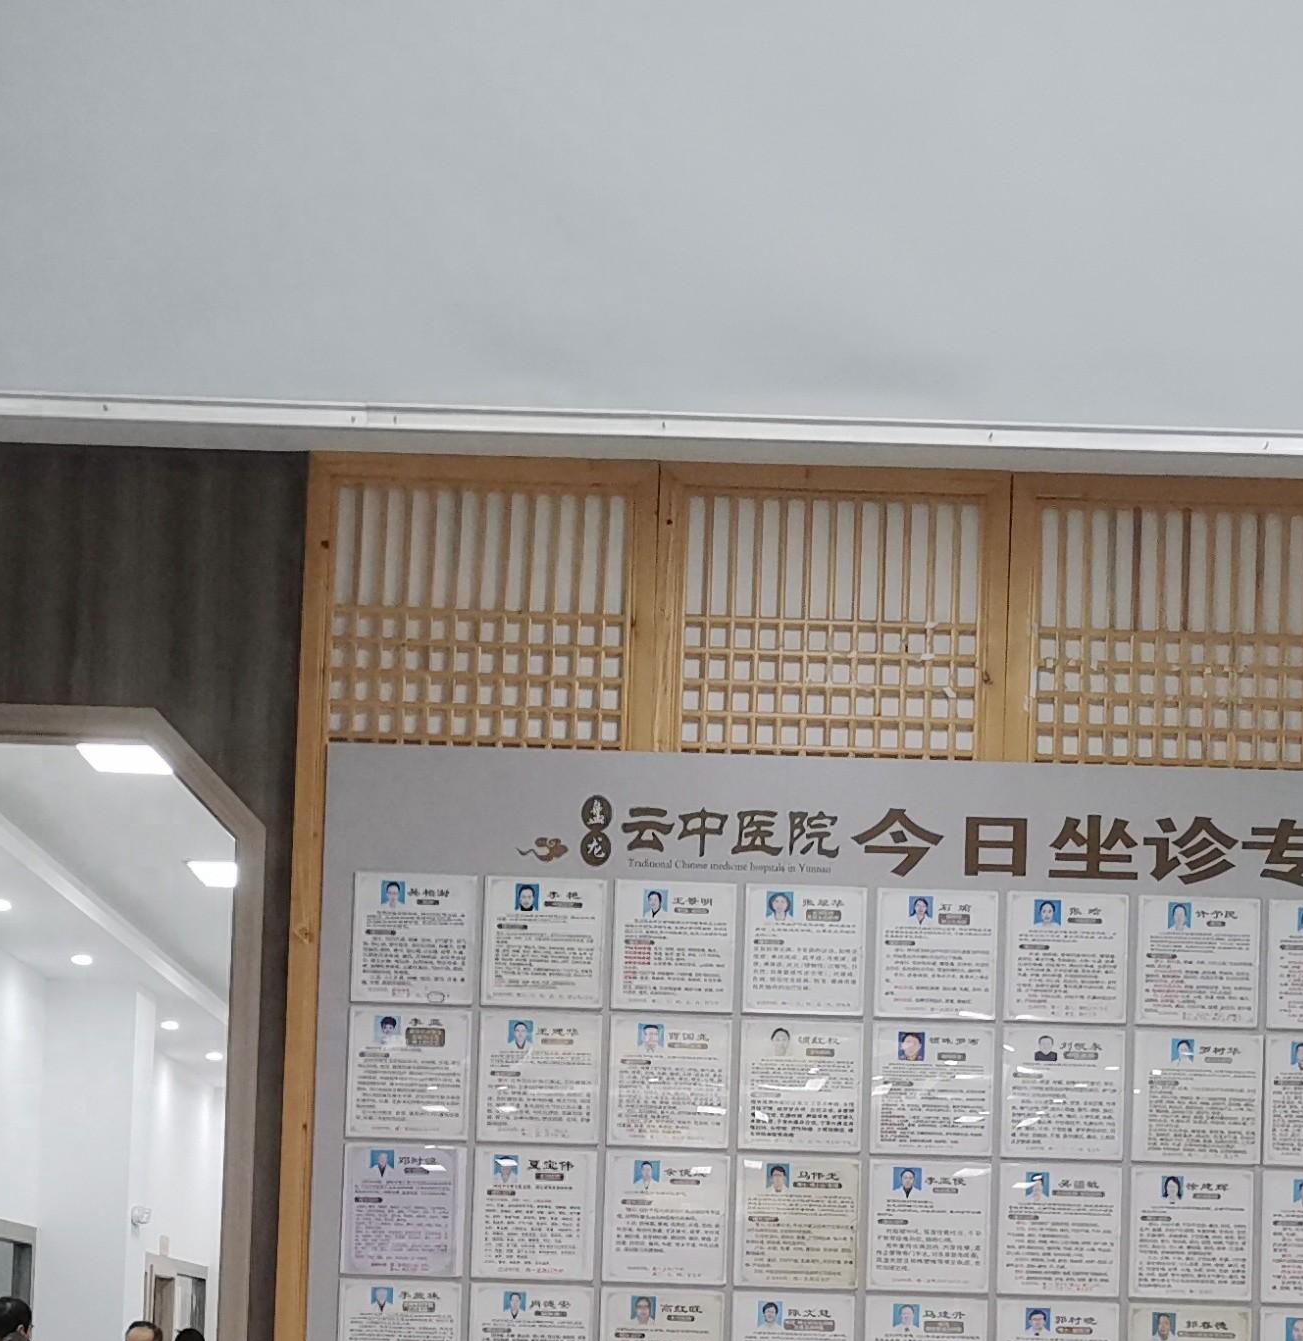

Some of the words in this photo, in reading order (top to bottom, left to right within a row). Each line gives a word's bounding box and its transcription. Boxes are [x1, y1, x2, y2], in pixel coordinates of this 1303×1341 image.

[621, 806, 841, 858] 云中医院
[628, 858, 672, 869] Traditional
[674, 860, 708, 870] Chinese
[710, 862, 747, 872] medicine
[749, 862, 786, 875] hospitals
[788, 864, 796, 873] in
[798, 863, 833, 874] Yunnan
